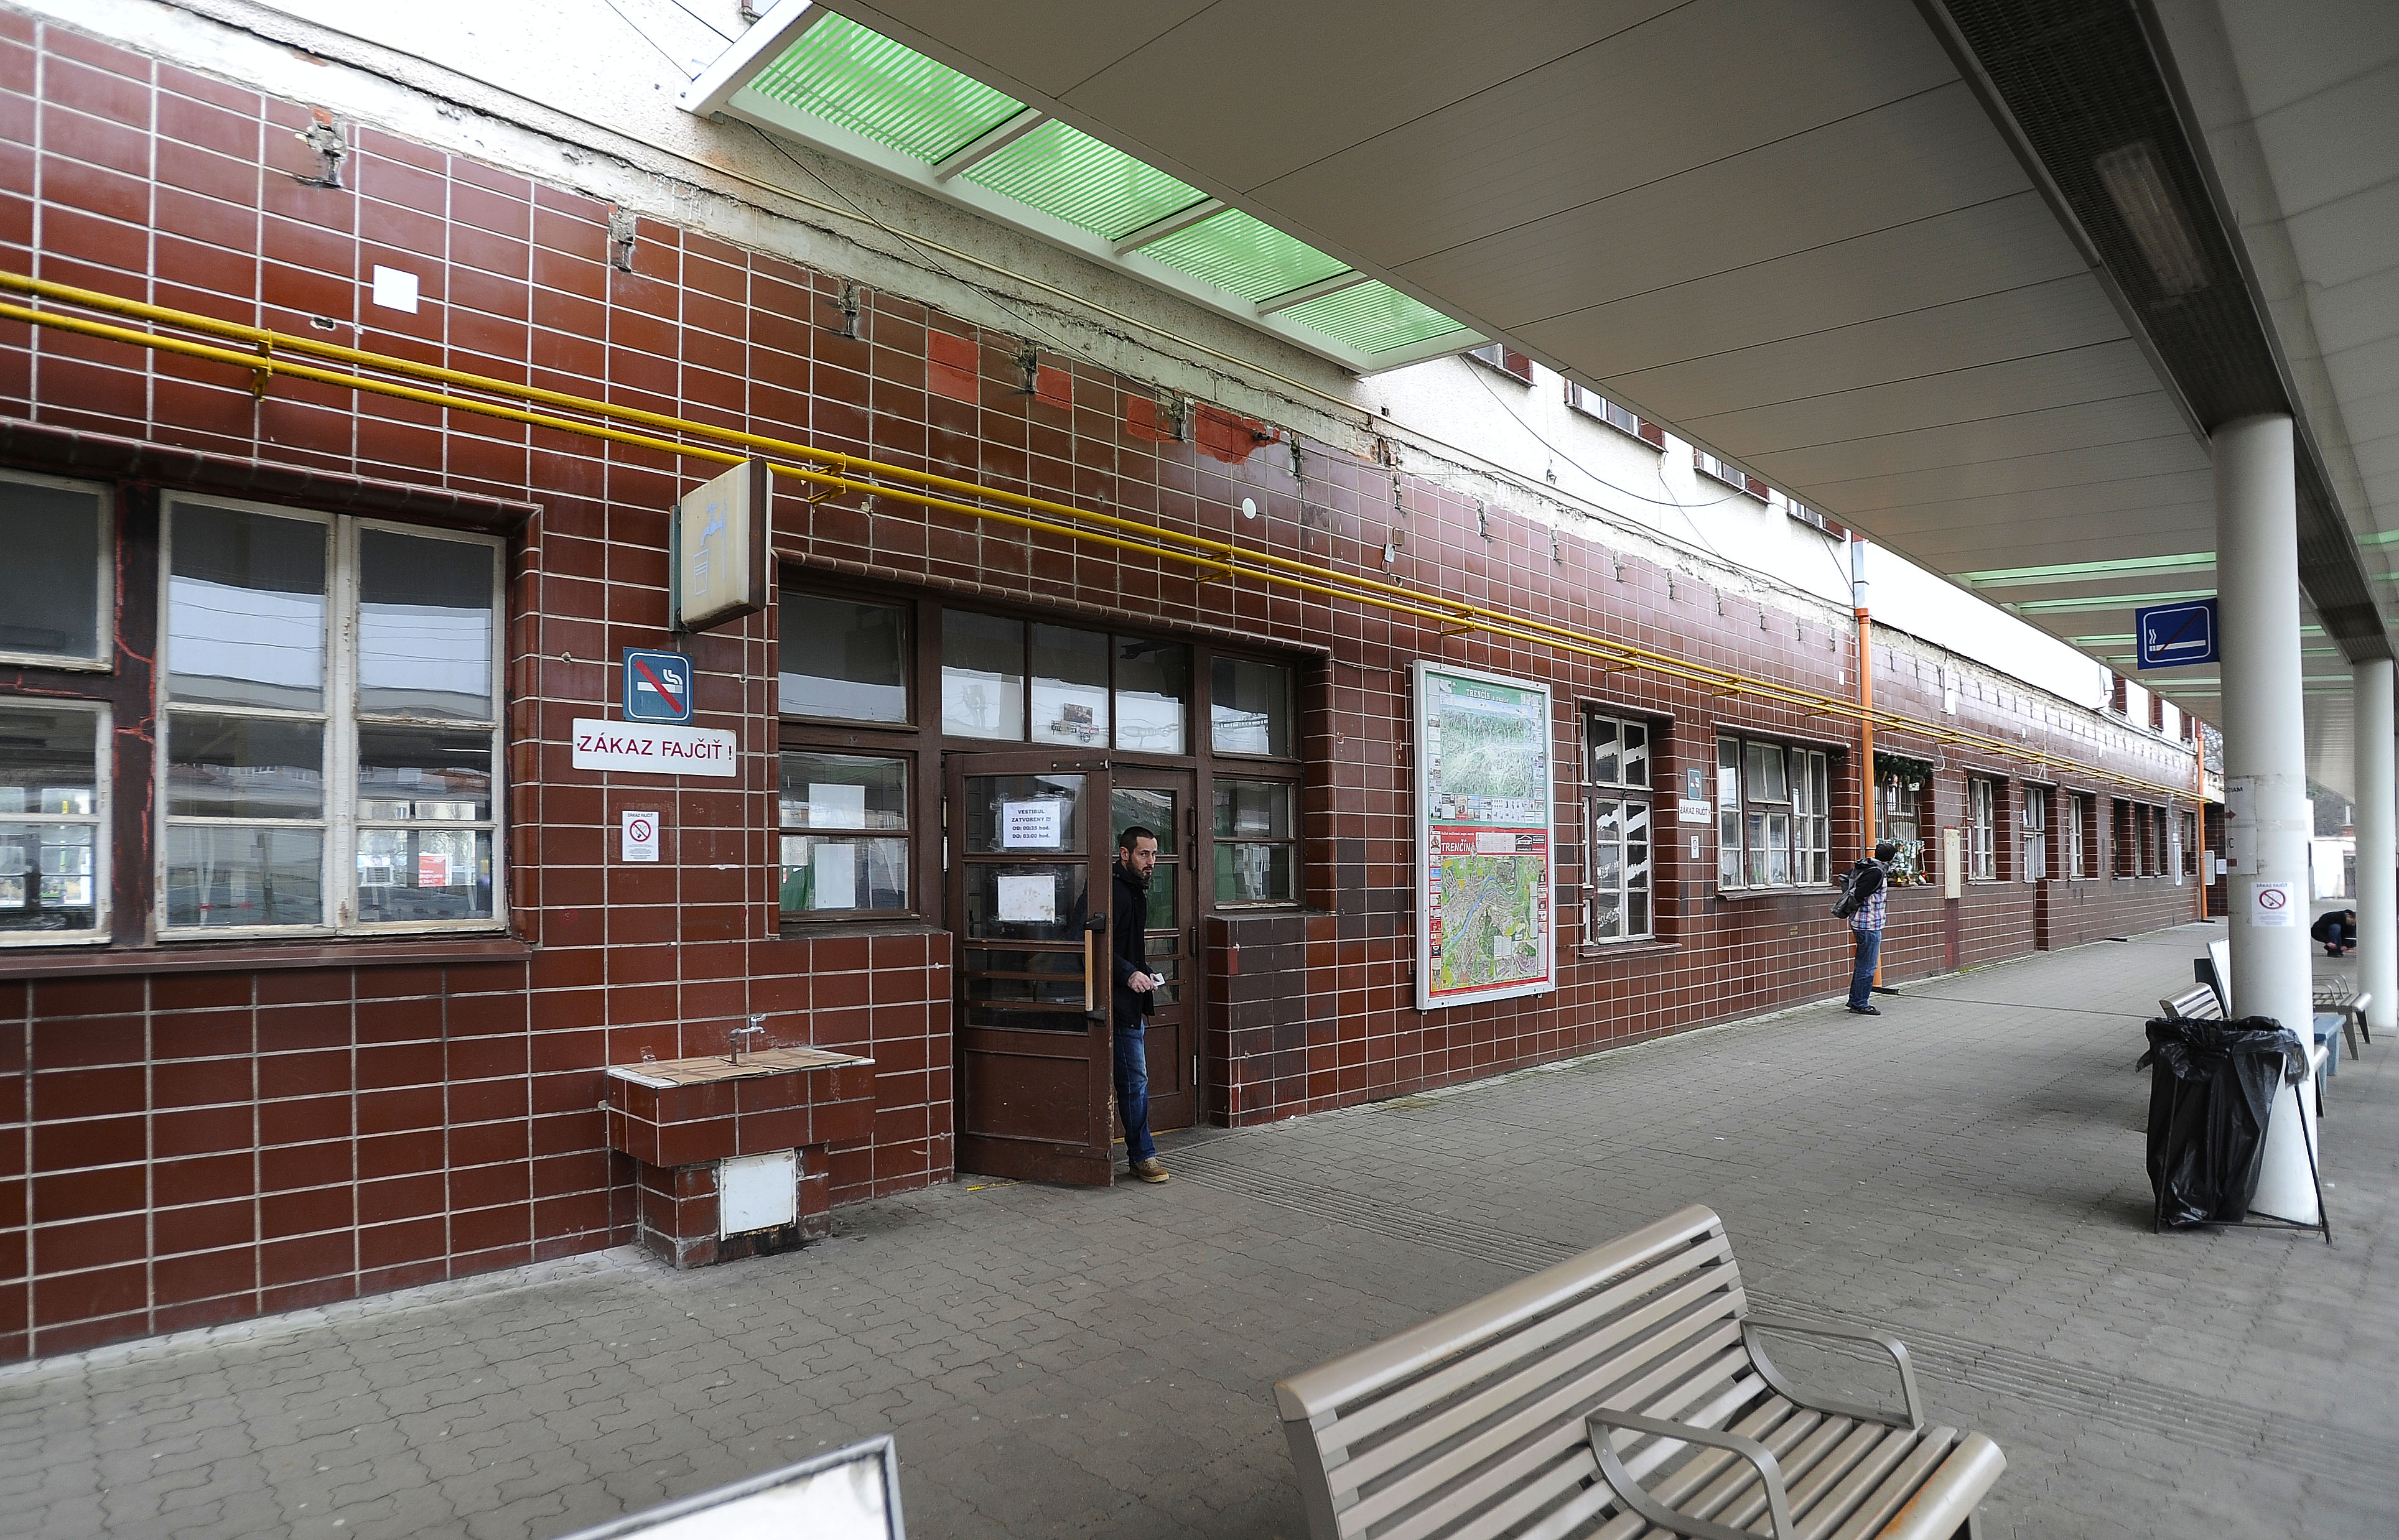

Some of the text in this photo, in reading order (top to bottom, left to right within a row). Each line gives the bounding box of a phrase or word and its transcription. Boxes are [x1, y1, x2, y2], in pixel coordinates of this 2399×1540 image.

[1466, 689, 1491, 700] TRENČÍN
[579, 732, 733, 761] ZÁKAZ FAJČIŤ !
[1680, 805, 1695, 815] ZÁKAZ
[1696, 806, 1708, 816] FAJČIŤ
[1441, 838, 1471, 852] TRENČÍN
